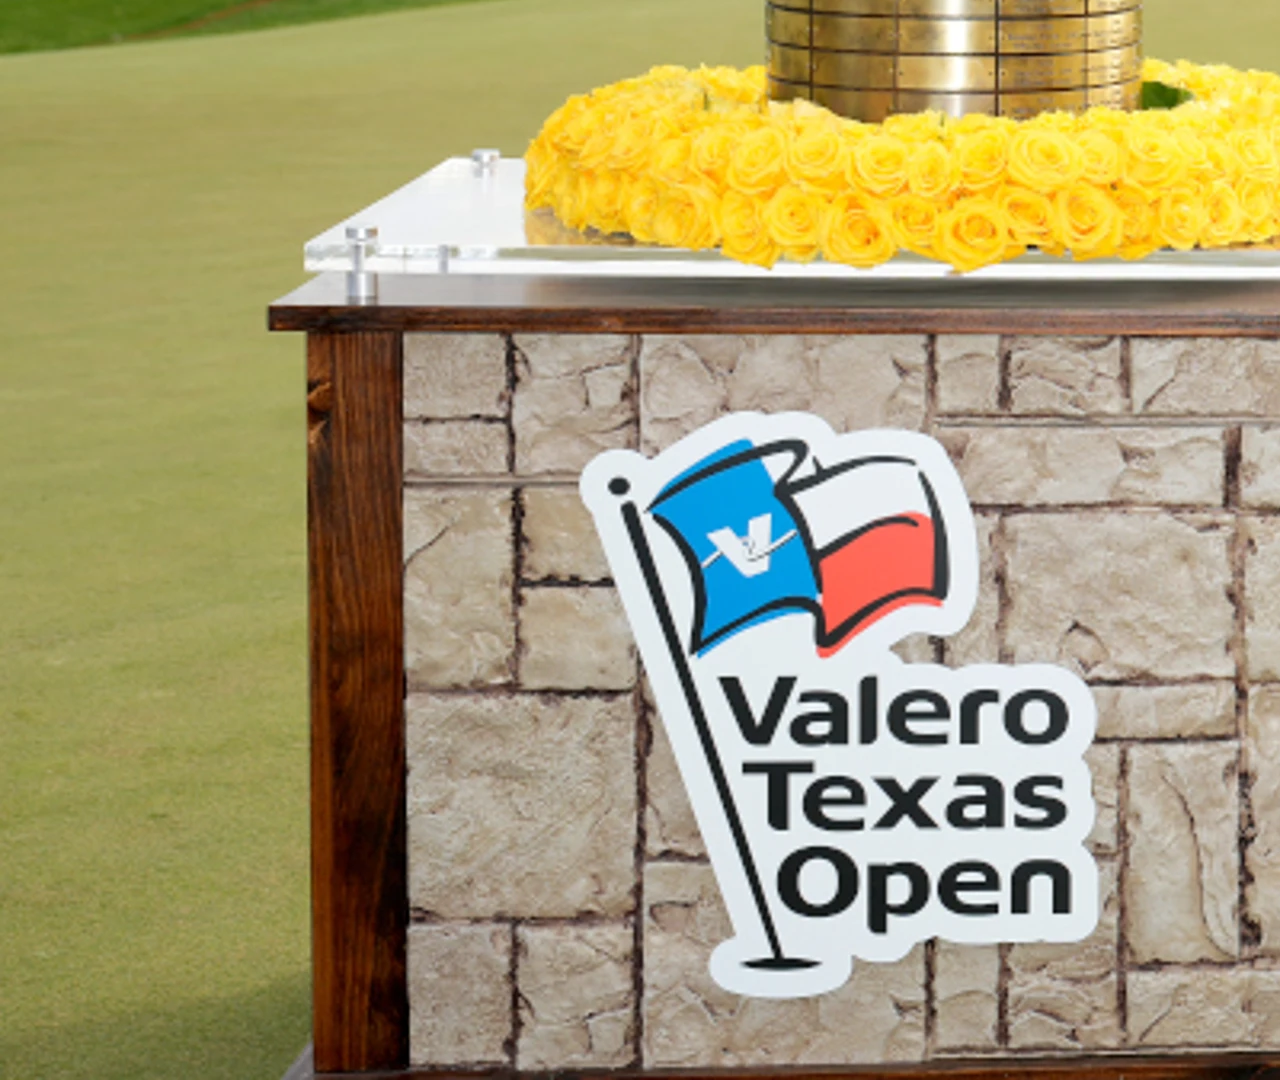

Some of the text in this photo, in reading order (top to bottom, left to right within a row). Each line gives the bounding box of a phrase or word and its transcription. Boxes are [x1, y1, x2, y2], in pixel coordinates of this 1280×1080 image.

[718, 675, 1070, 745] Valero
[741, 760, 1068, 831] Texas
[776, 846, 1073, 935] Open
